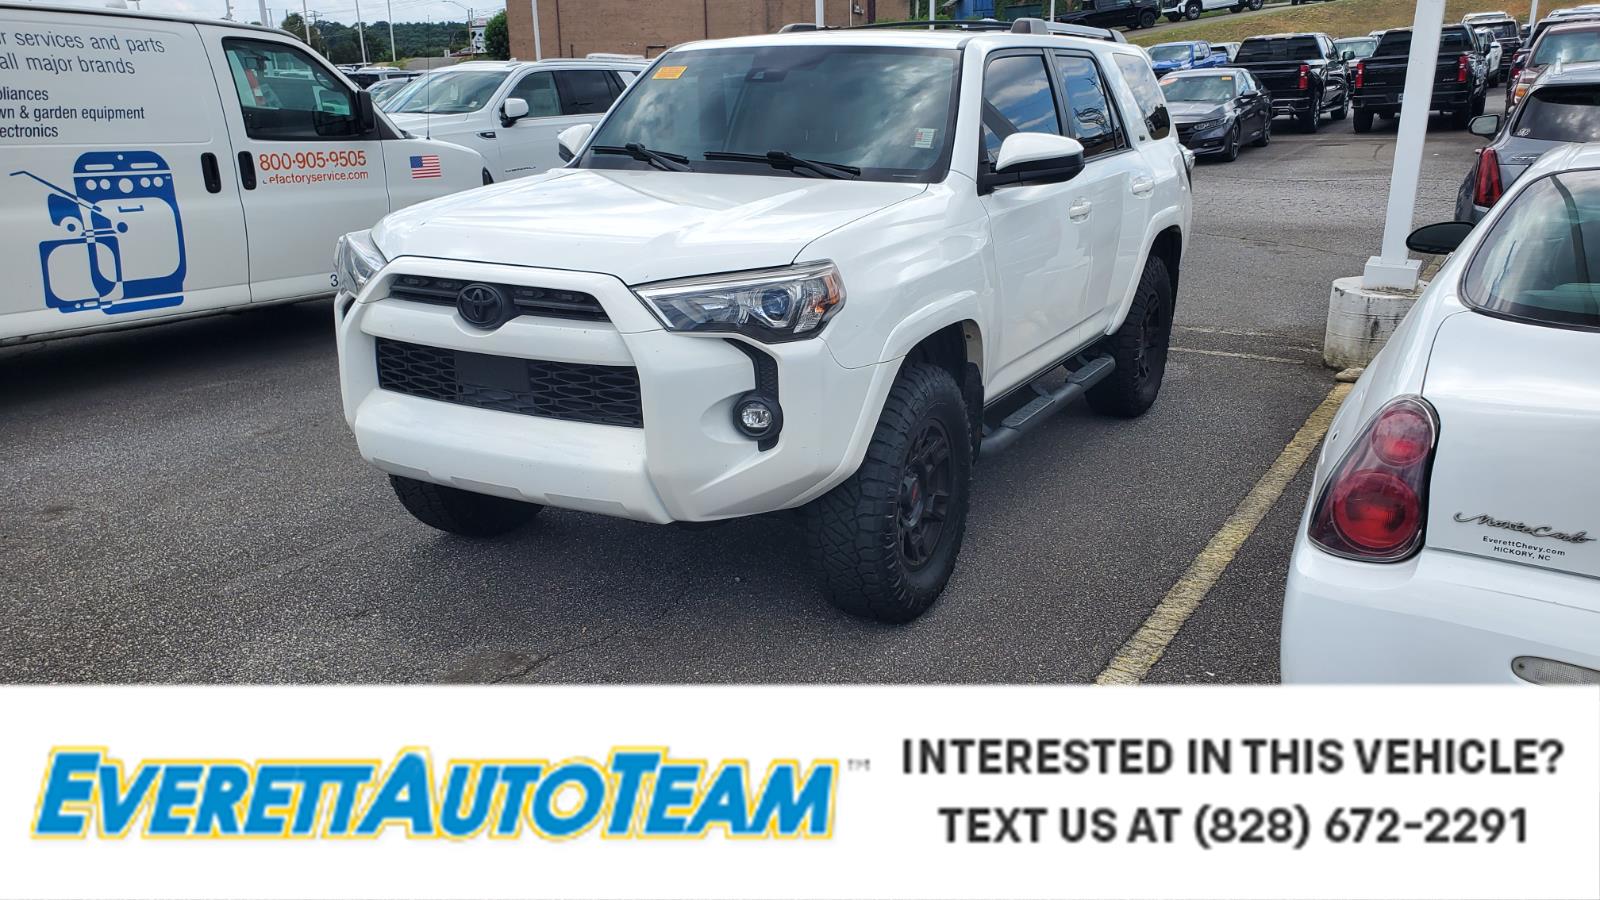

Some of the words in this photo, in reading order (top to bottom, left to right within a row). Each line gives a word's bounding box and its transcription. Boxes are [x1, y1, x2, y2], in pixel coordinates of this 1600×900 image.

[15, 31, 85, 49] services
[90, 35, 121, 51] and
[126, 37, 165, 55] parts
[0, 52, 19, 70] all
[26, 54, 73, 75] major
[78, 56, 136, 75] brands
[20, 105, 30, 119] &
[34, 105, 78, 122] garden
[82, 106, 145, 122] equipment
[0, 124, 59, 138] ectronics
[263, 171, 369, 185] efactoryservice.com
[330, 274, 339, 287] 3
[1482, 535, 1566, 556] EverettChevy.com
[1493, 546, 1535, 559] HICKORY,
